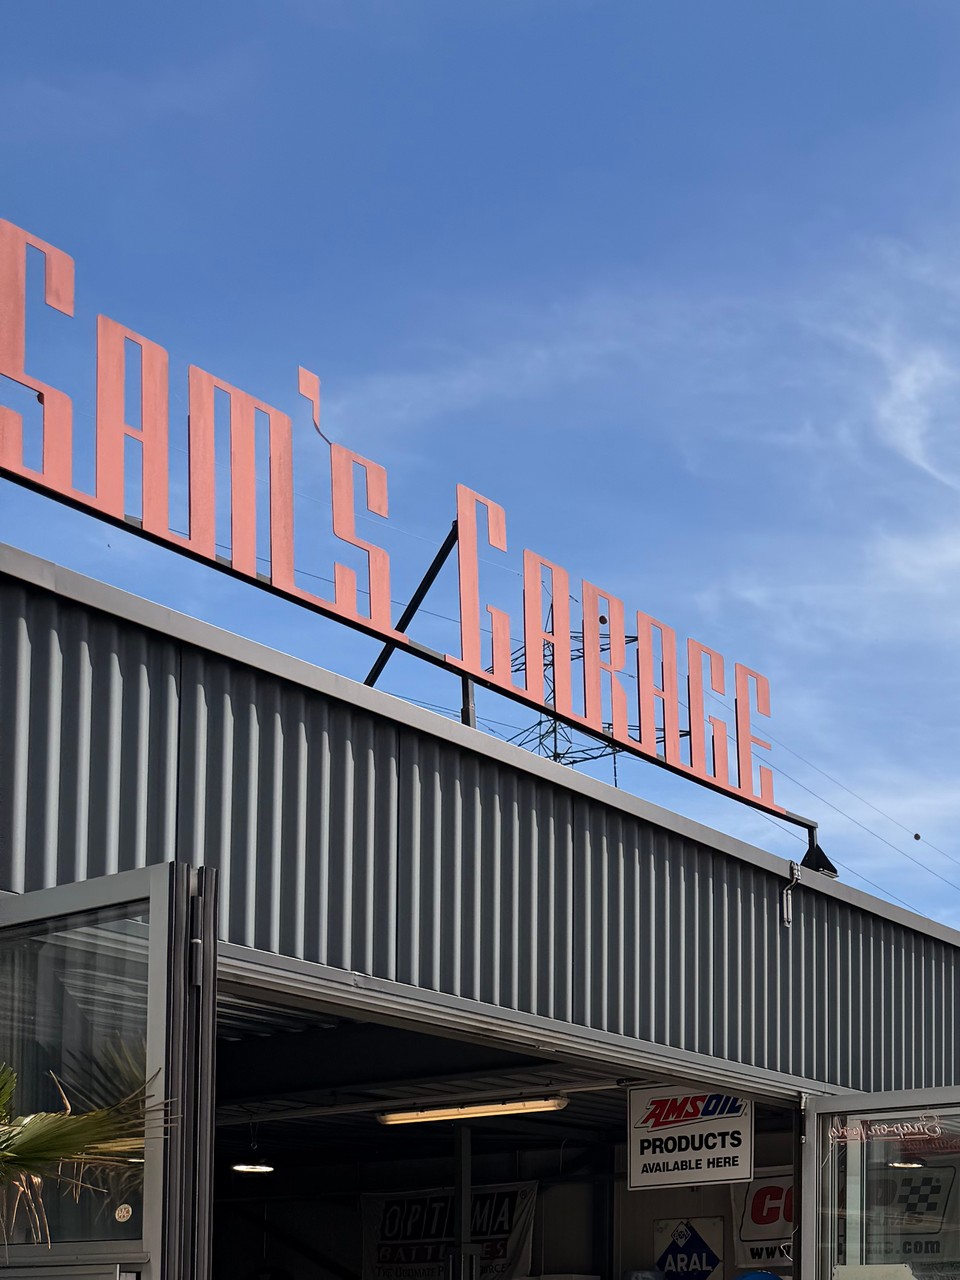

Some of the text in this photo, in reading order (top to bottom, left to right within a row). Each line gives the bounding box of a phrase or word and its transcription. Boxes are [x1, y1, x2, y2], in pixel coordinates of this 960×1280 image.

[445, 483, 786, 814] GARAGE
[640, 1093, 746, 1128] AMSOIL
[640, 1131, 743, 1156] PRODUCTS
[641, 1156, 740, 1175] AVAILABLE HERE
[383, 1197, 511, 1238] OPTMA
[664, 1252, 714, 1273] ARAL
